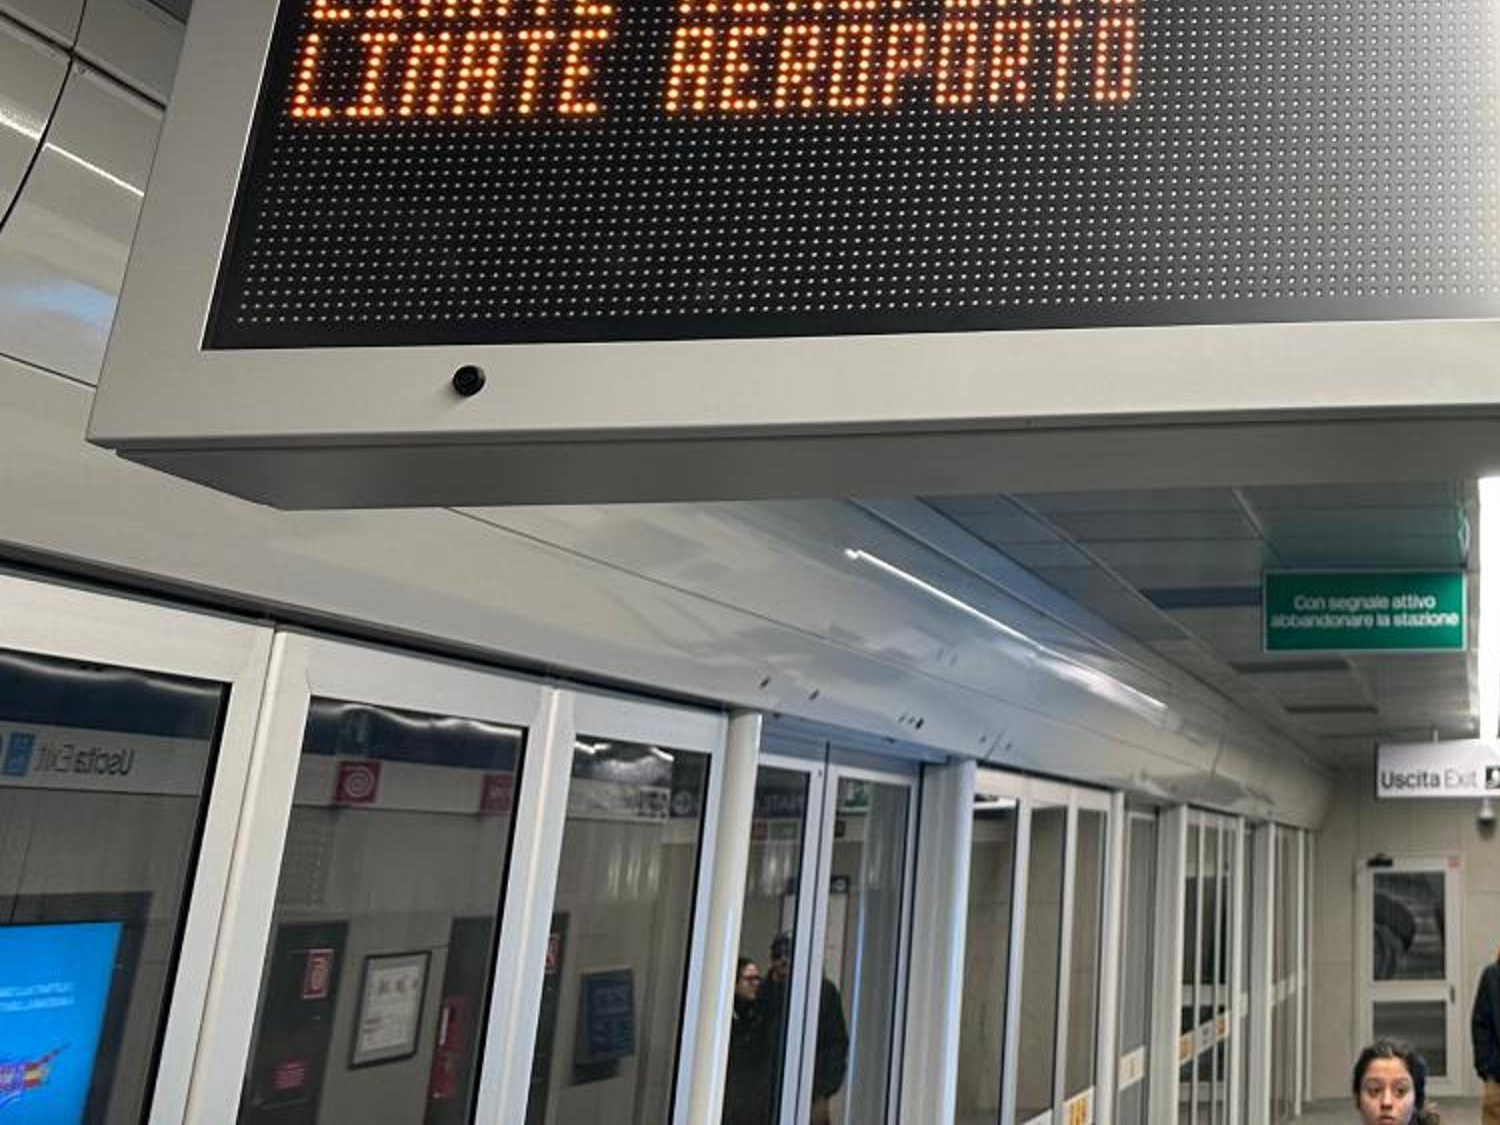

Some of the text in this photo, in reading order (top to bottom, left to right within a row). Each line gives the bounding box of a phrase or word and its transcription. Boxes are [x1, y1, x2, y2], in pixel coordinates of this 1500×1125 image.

[292, 17, 1136, 117] LINATE AEROPORTO
[1293, 594, 1436, 613] Con segnale attivo
[1270, 612, 1459, 628] abbandonare la stazione
[1380, 769, 1478, 790] Uscita Exit
